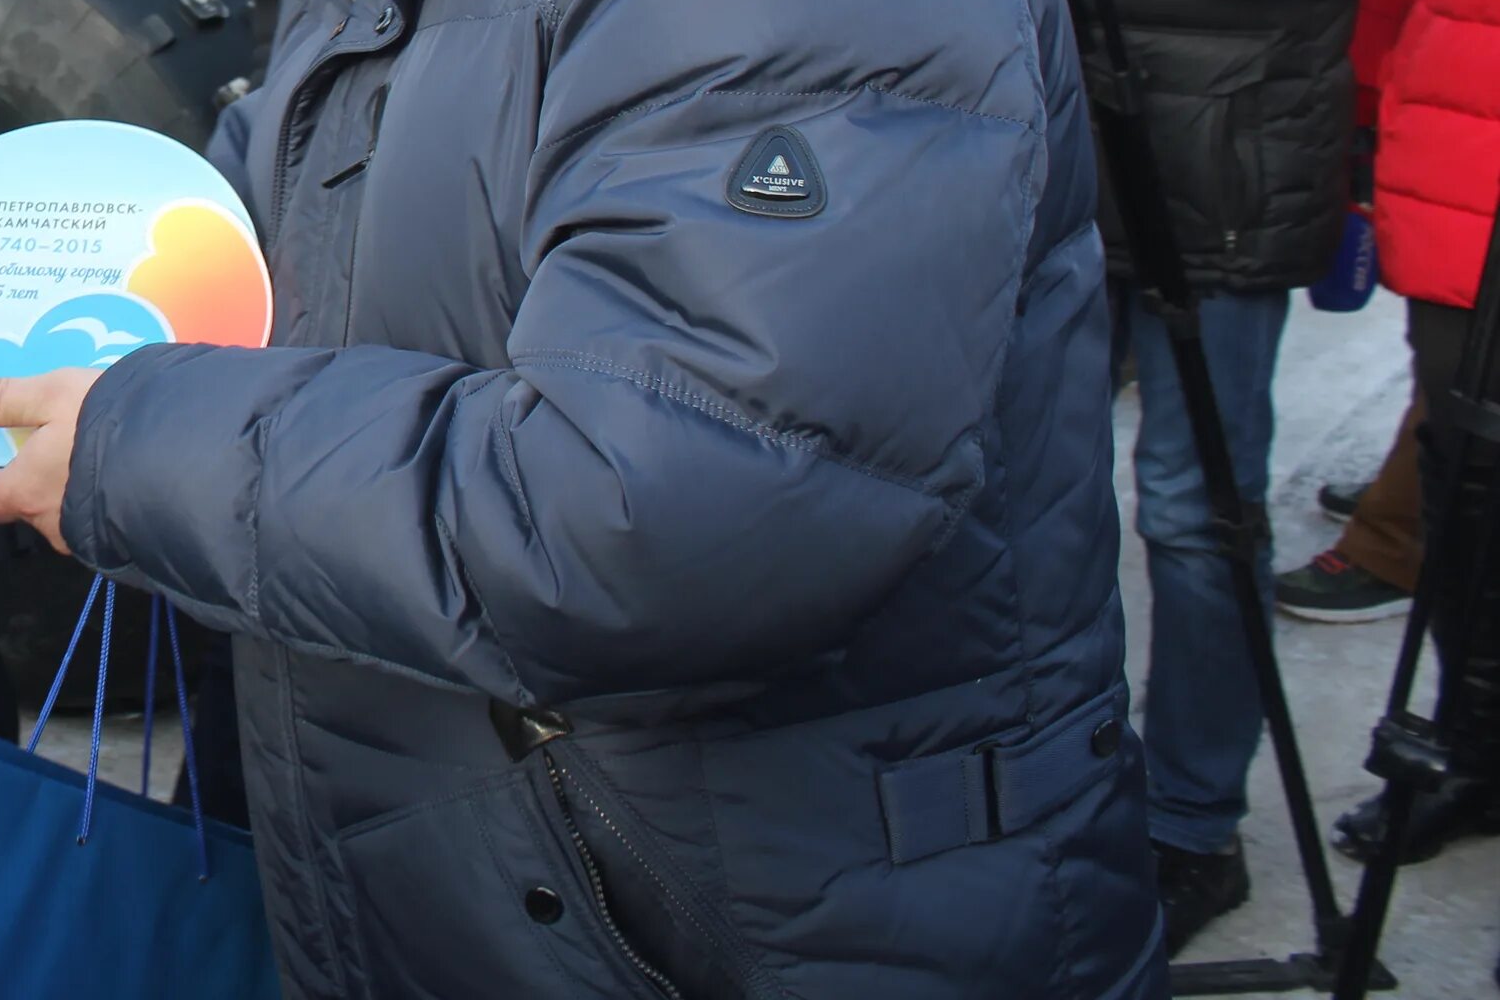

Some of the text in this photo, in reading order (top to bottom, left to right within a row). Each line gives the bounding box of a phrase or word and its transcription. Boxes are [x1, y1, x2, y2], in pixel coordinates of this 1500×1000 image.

[752, 175, 805, 186] X'CLUSIVE
[69, 267, 123, 286] городу
[5, 287, 39, 300] лет
